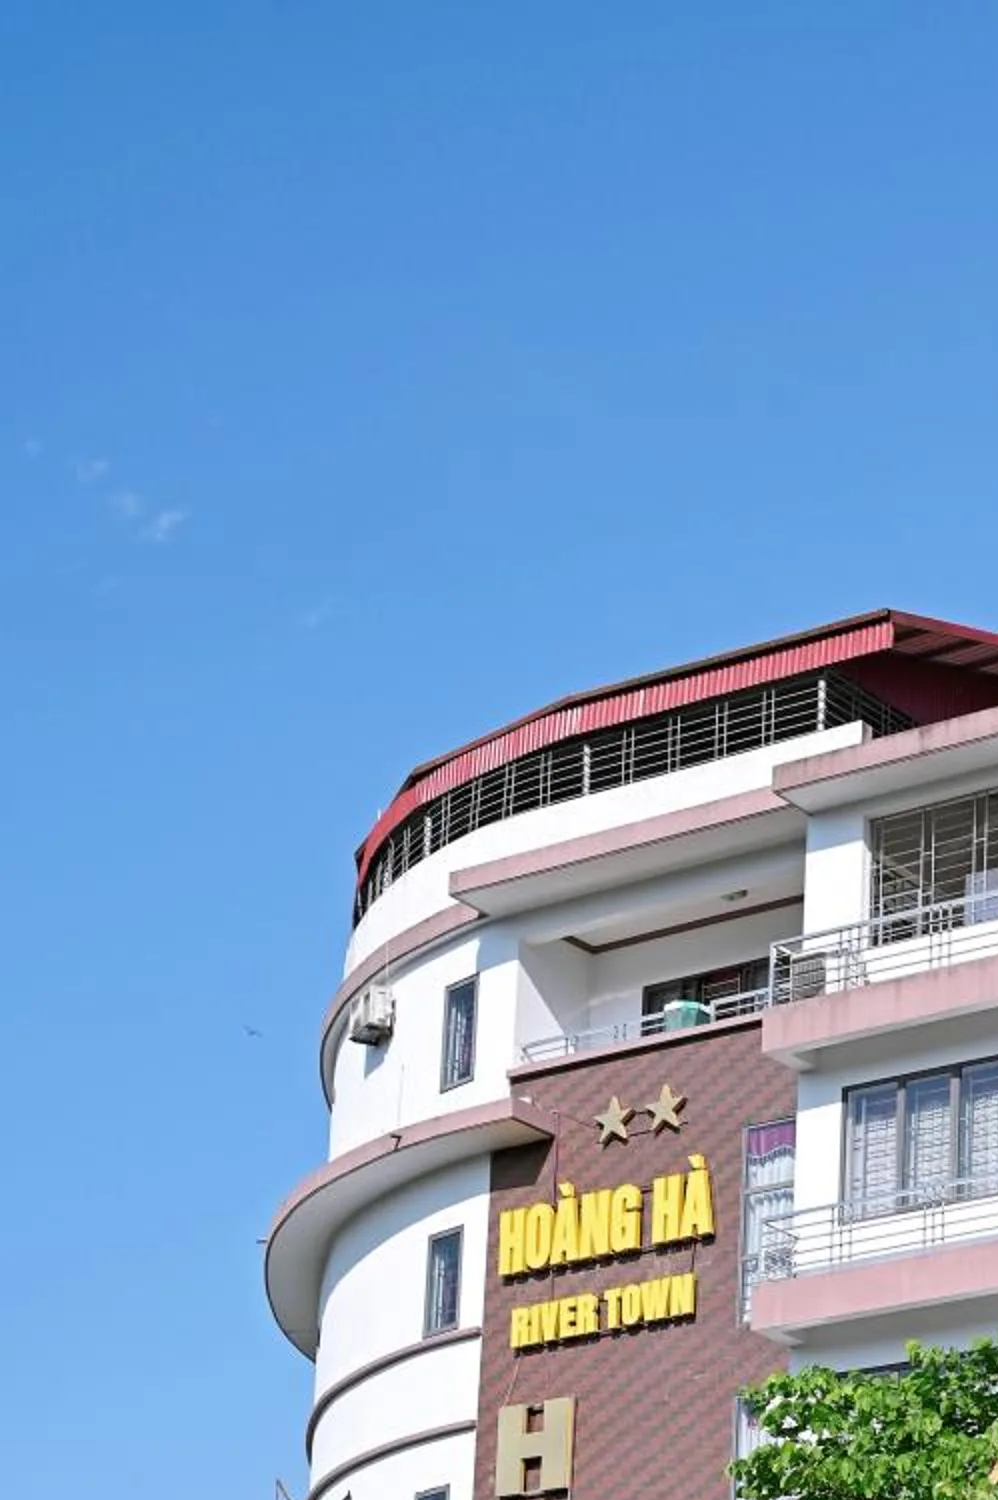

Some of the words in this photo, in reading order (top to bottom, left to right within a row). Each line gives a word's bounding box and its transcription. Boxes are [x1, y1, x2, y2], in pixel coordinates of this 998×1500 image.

[499, 1181, 643, 1278] HOÀNG
[652, 1153, 716, 1246] HÀ
[510, 1293, 600, 1350] RIVER
[604, 1273, 698, 1330] TOWN
